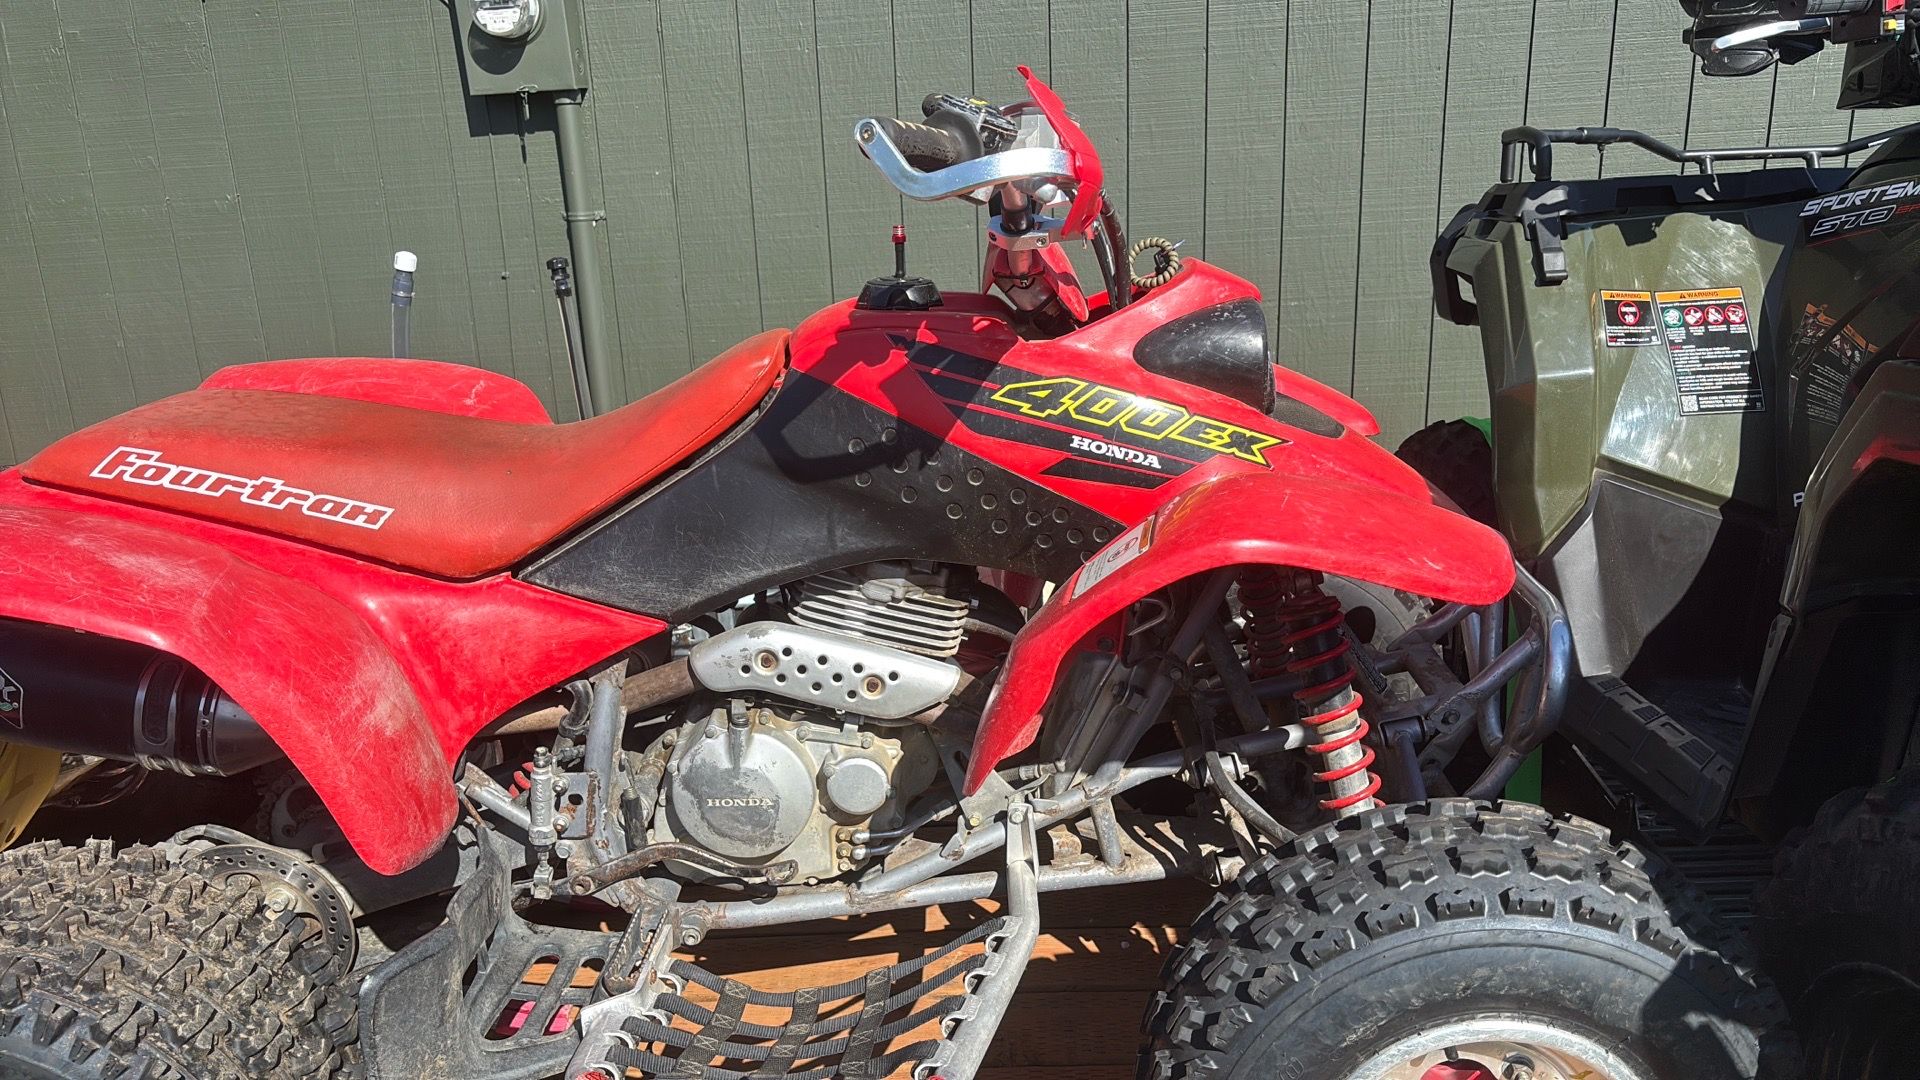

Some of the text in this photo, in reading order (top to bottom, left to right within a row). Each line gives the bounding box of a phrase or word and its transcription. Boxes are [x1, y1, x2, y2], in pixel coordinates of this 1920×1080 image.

[1810, 205, 1897, 237] 570
[990, 377, 1284, 466] 400EX
[1069, 435, 1162, 470] HONDA
[89, 446, 395, 530] Fourtrax
[706, 798, 774, 807] HONDA
